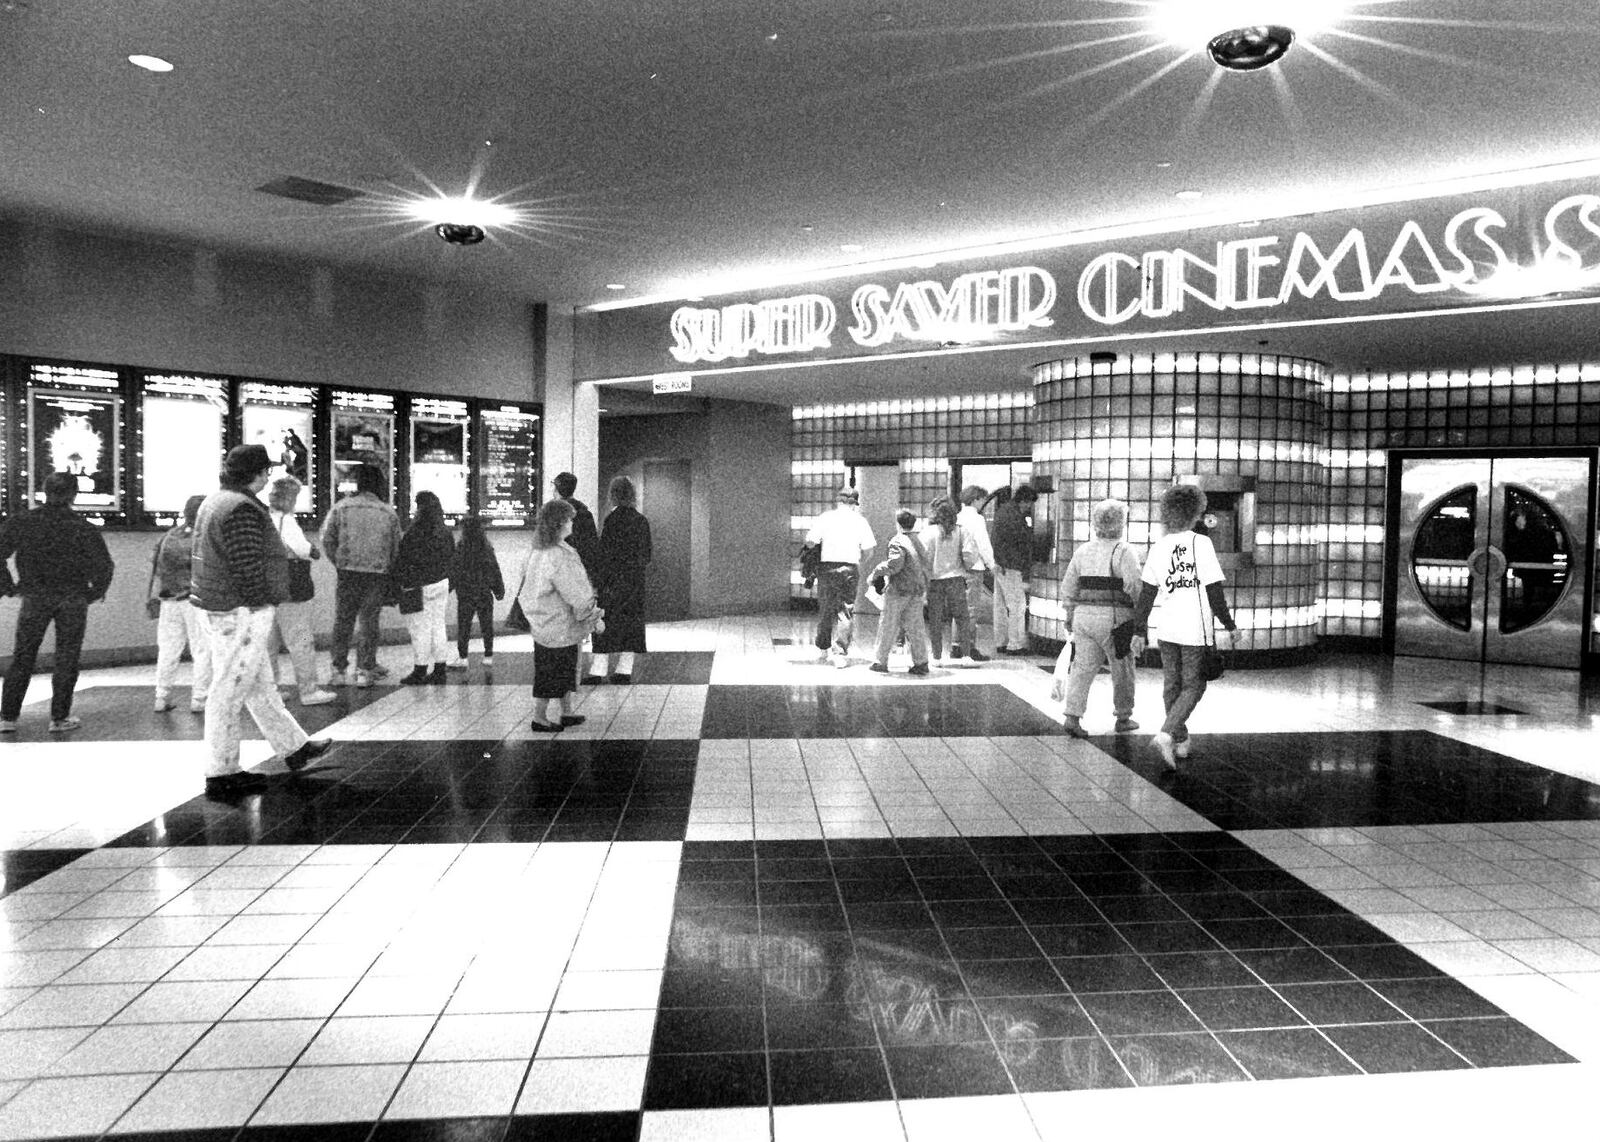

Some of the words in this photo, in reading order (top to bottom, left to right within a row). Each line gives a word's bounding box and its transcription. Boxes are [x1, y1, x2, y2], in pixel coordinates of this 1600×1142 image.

[668, 294, 837, 363] SUPER
[847, 266, 1057, 347] SAVER
[1077, 207, 1510, 325] CINEMAS
